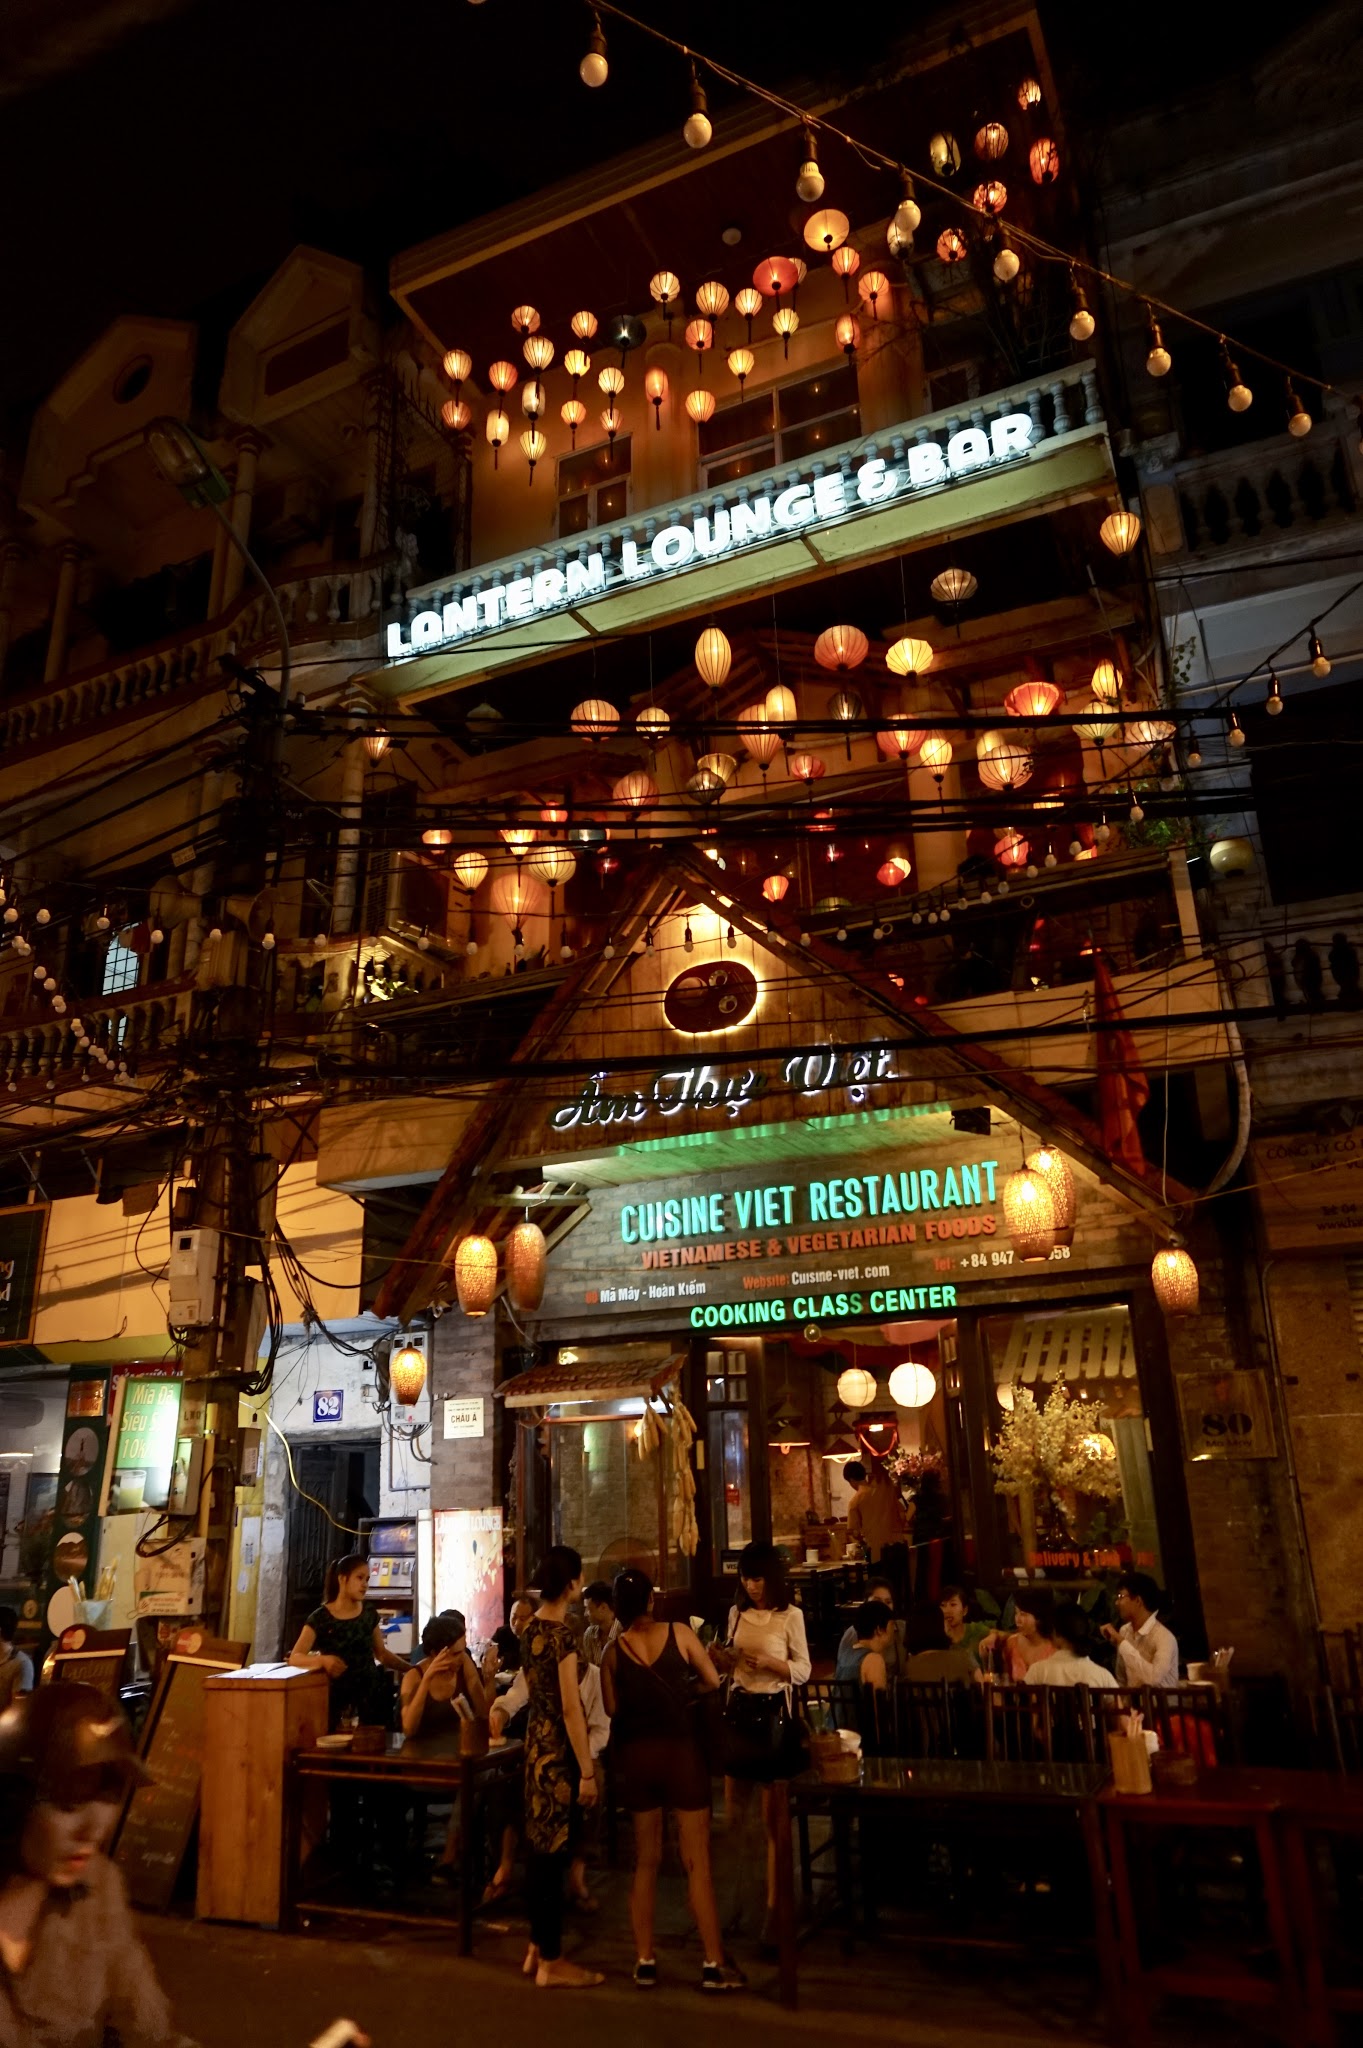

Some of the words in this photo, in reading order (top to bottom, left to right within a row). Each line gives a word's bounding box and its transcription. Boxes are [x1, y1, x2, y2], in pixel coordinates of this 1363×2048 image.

[386, 552, 606, 659] LANTERN
[622, 470, 846, 580] LOUNGE
[856, 458, 898, 502] &
[909, 412, 1036, 488] BAR
[621, 1193, 725, 1244] CUISINE
[734, 1185, 796, 1229] VIET
[809, 1160, 998, 1221] RESTAURANT
[641, 1239, 762, 1270] VIETNAMESE
[767, 1238, 782, 1257] &
[787, 1223, 917, 1255] VEGETARIAN
[925, 1214, 997, 1241] FOODS
[1047, 1246, 1071, 1261] 58
[742, 1274, 790, 1290] Website:
[690, 1299, 786, 1328] COOKING
[793, 1292, 863, 1319] CLASS
[870, 1285, 957, 1313] CENTER
[317, 1396, 339, 1416] 82
[1202, 1413, 1252, 1436] 80
